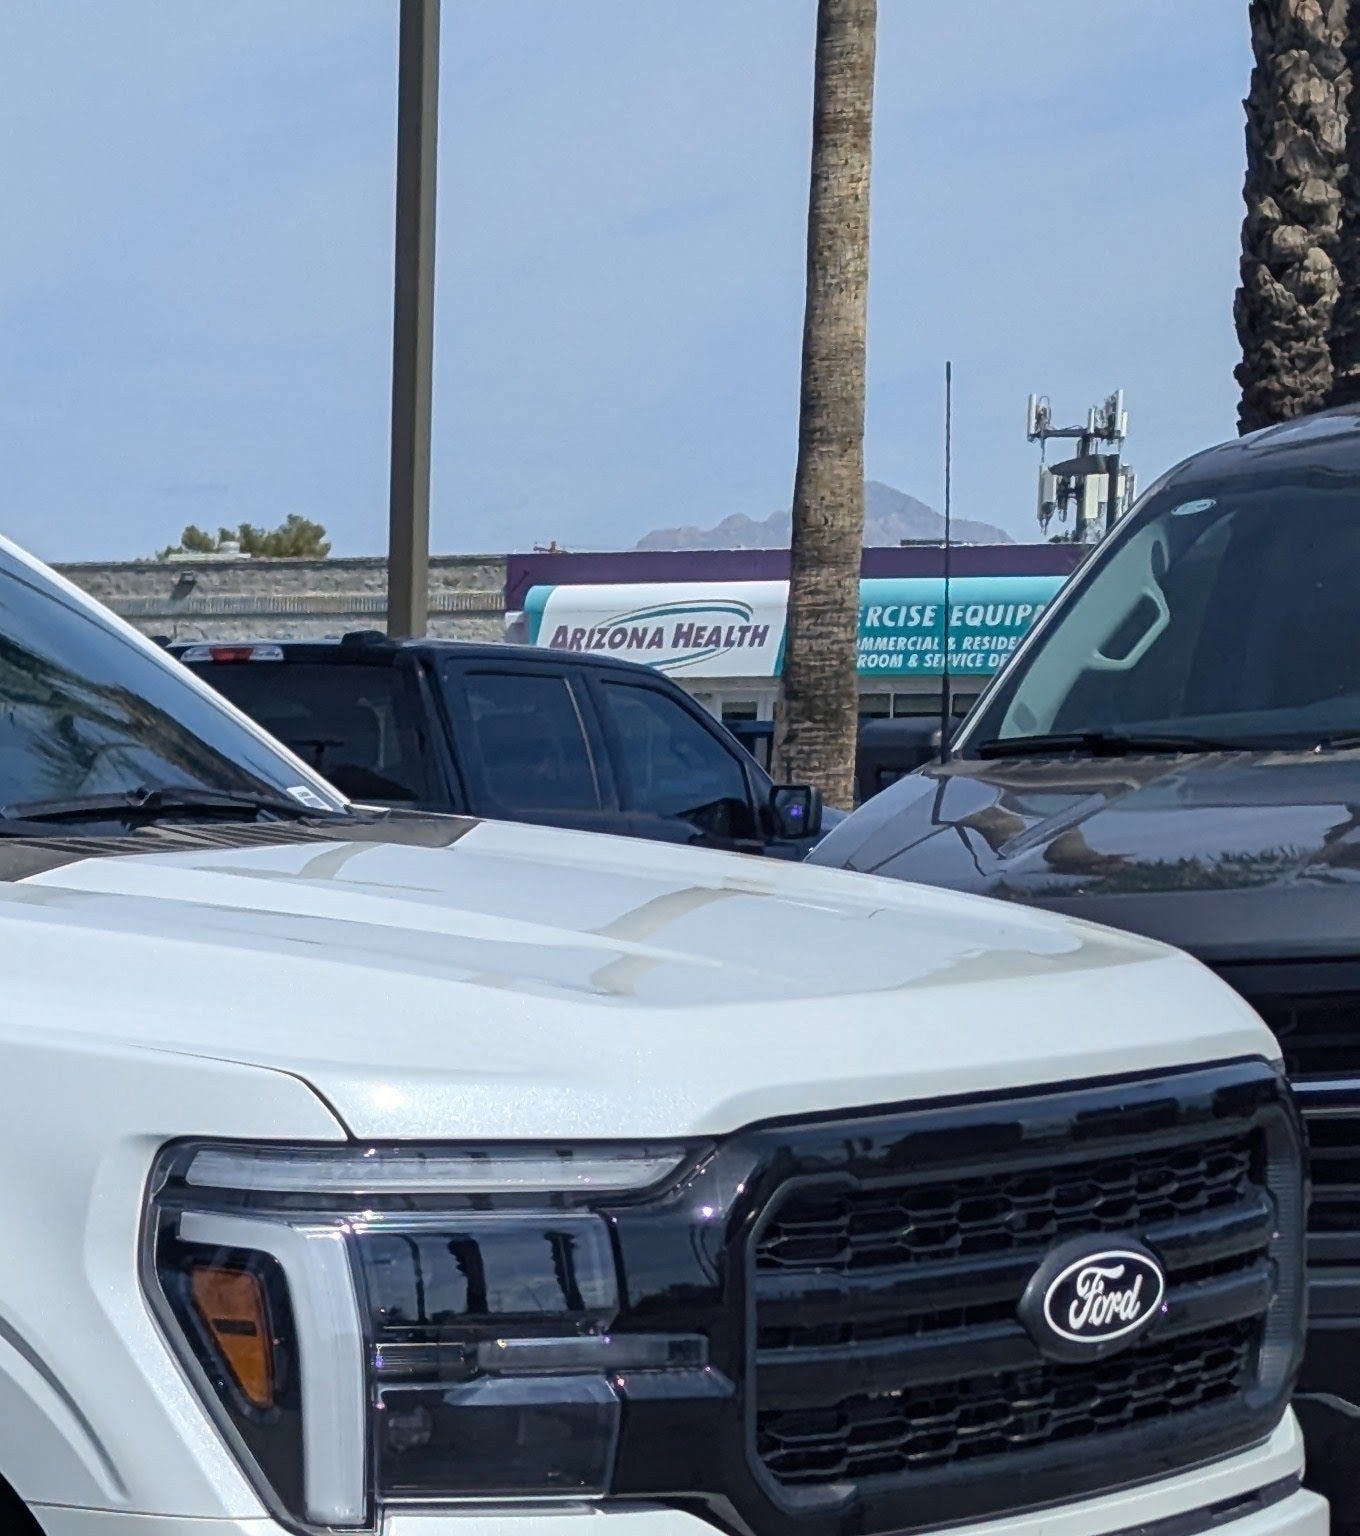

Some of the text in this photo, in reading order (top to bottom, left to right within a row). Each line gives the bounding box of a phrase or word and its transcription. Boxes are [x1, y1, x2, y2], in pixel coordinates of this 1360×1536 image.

[549, 622, 770, 650] ARIZONA HEALTH
[907, 653, 919, 668] &
[1068, 1264, 1143, 1330] Ford
